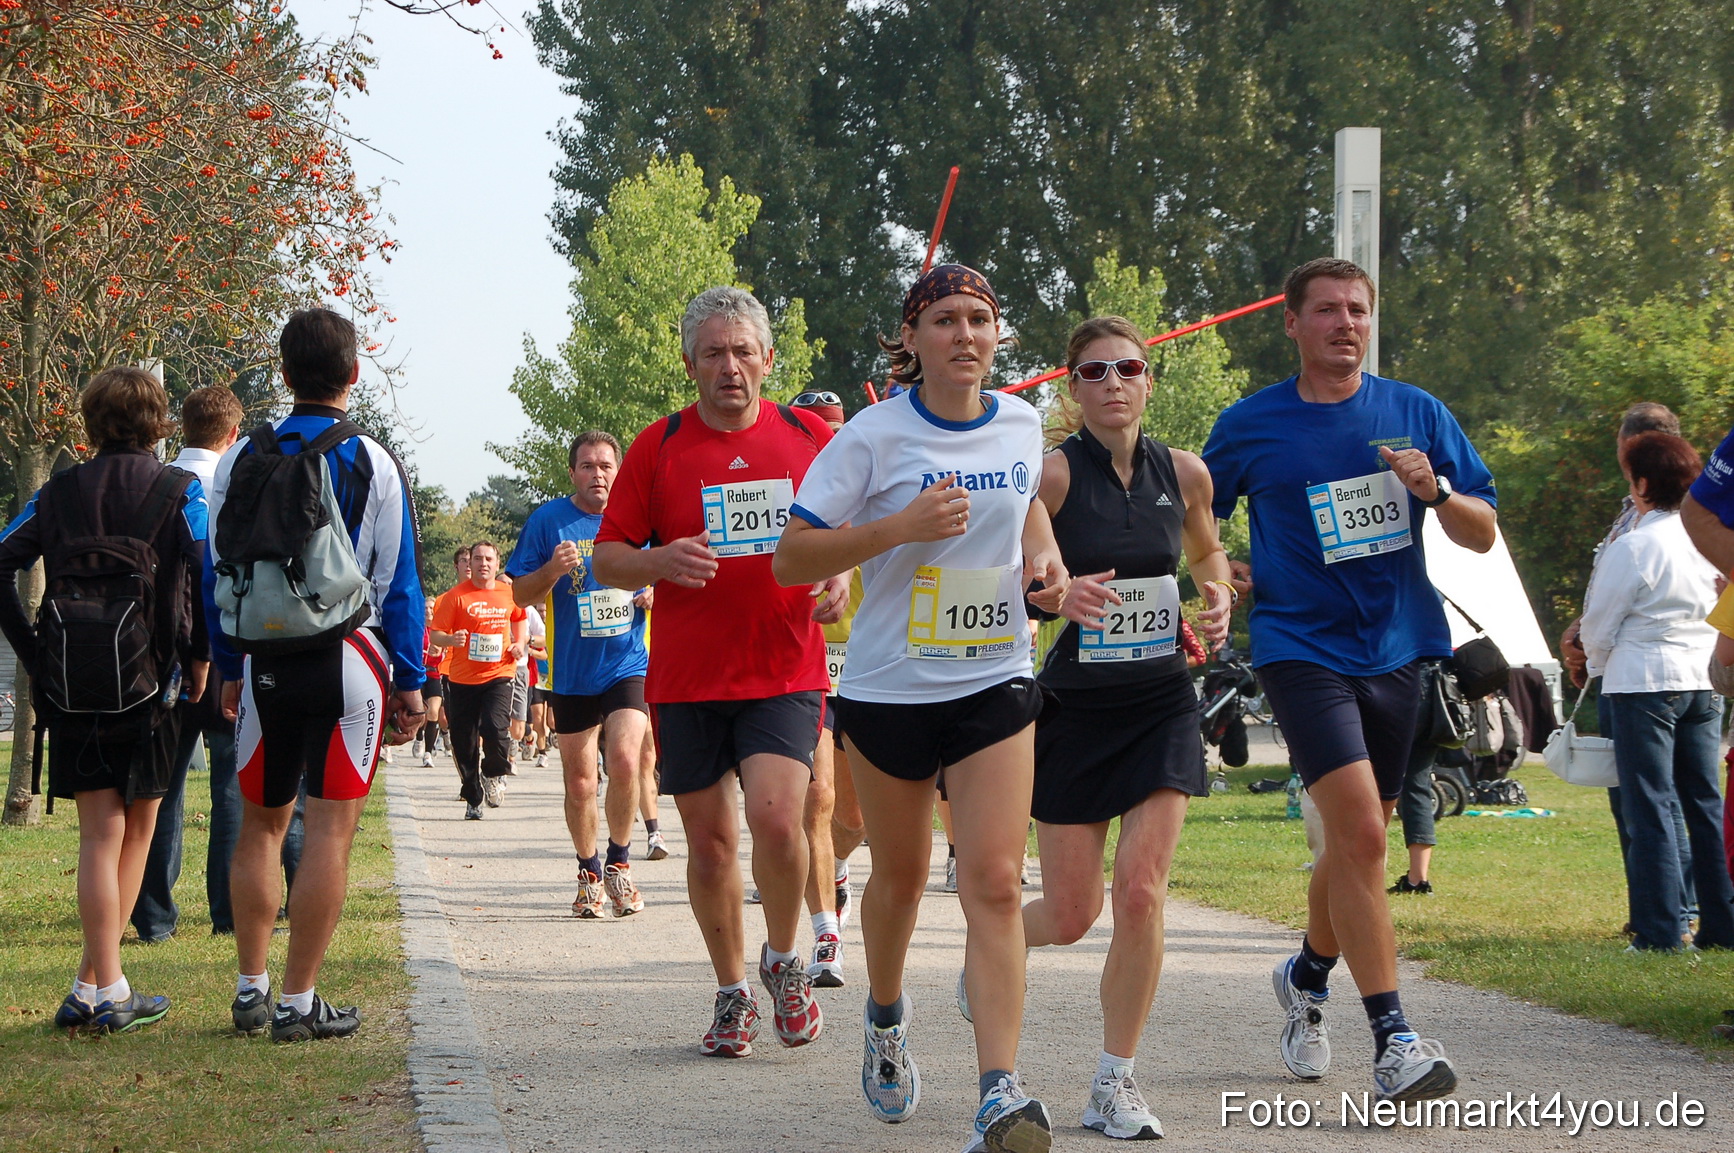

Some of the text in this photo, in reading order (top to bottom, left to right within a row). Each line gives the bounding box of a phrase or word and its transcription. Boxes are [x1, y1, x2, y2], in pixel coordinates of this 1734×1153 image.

[727, 488, 767, 503] Robert
[1335, 482, 1371, 501] Bernd
[708, 512, 714, 523] C
[730, 508, 789, 532] 2015
[1319, 513, 1326, 525] C
[1342, 501, 1400, 530] 3303
[593, 595, 610, 604] Fritz
[597, 605, 629, 620] 3268
[945, 601, 1009, 629] 1035
[1109, 608, 1170, 635] 2123
[480, 644, 499, 652] 3590
[978, 642, 1014, 653] PFLEIDERER
[1142, 642, 1174, 654] PFLEIDERER
